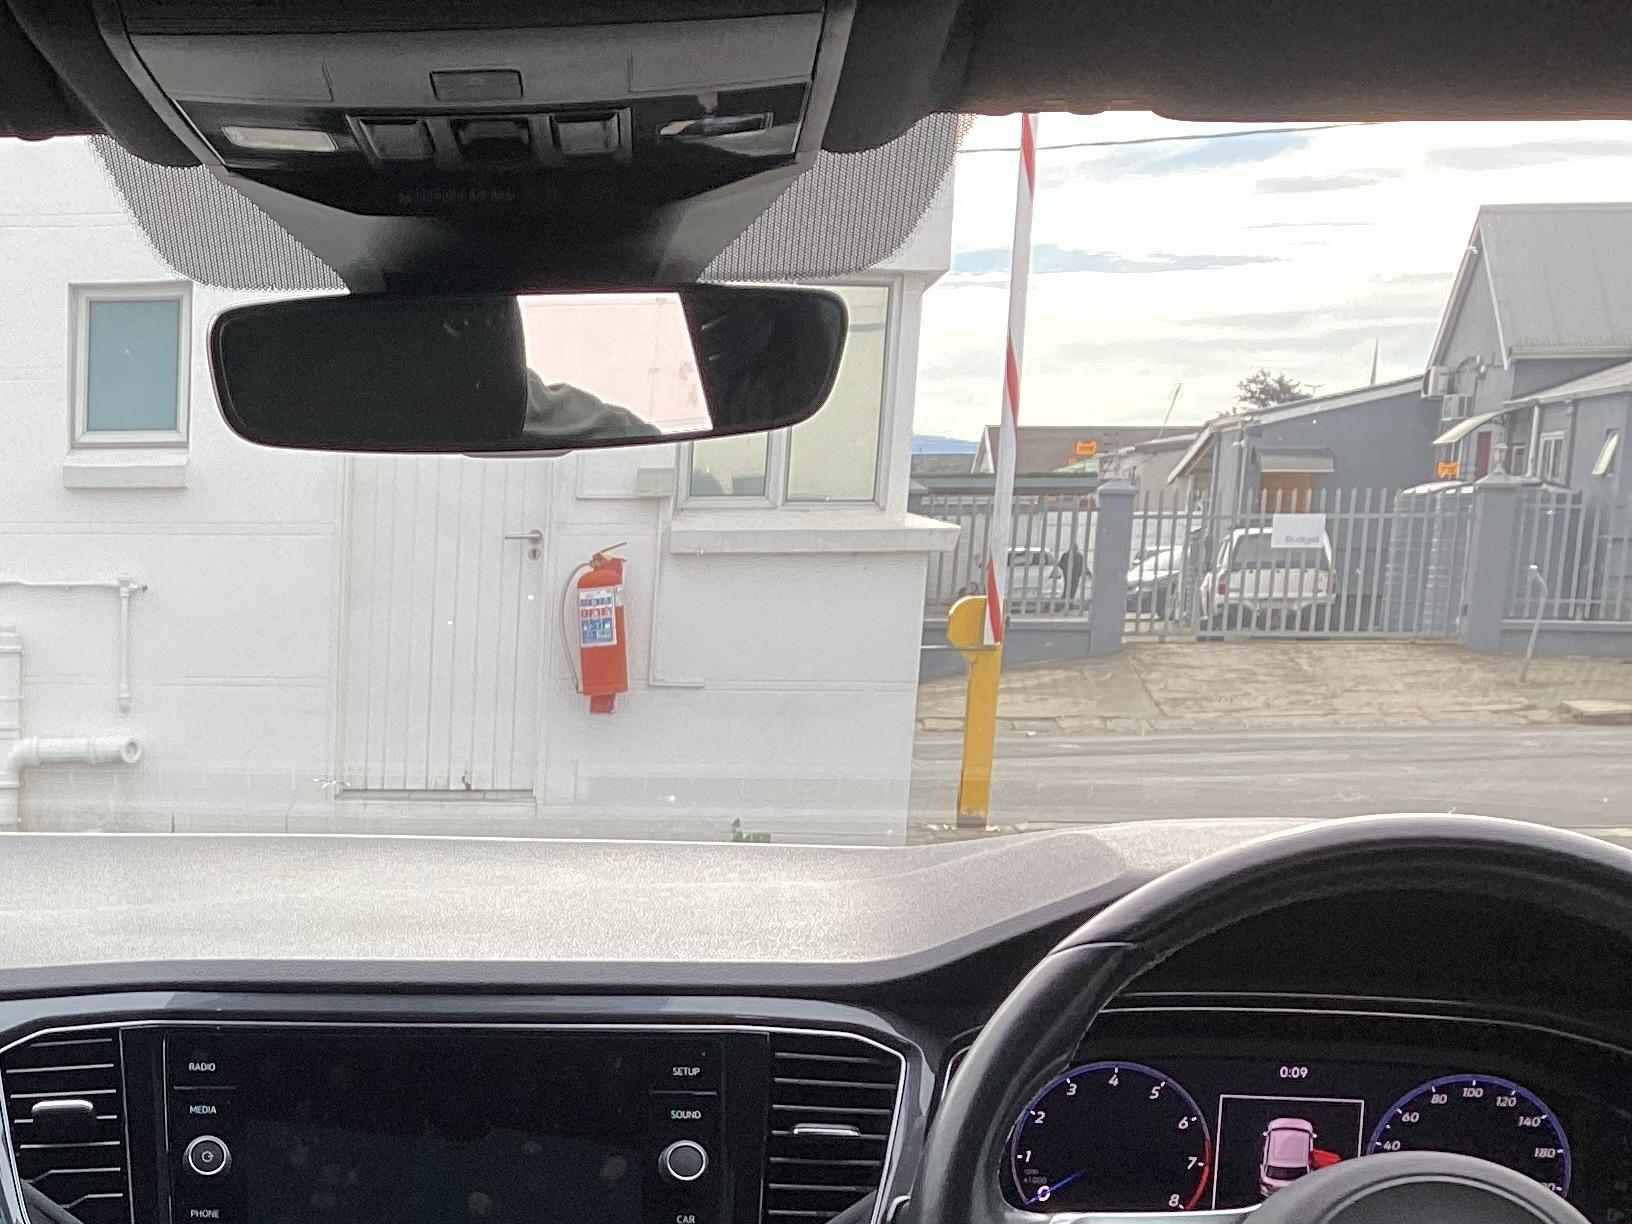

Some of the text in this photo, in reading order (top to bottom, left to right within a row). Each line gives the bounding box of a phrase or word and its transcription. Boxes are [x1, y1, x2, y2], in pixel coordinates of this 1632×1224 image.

[188, 1062, 216, 1072] RADIO
[672, 1067, 700, 1076] SETUP
[1279, 1066, 1308, 1078] 0:09
[1108, 1075, 1118, 1087] 4
[1066, 1084, 1077, 1096] 3
[1149, 1086, 1160, 1099] 5
[1462, 1087, 1484, 1098] 100
[1431, 1094, 1448, 1104] 80
[1496, 1096, 1517, 1107] 120
[189, 1105, 217, 1114] MEDIA
[671, 1110, 701, 1119] SOUND
[1034, 1111, 1046, 1124] 2
[1178, 1116, 1189, 1129] 6
[1402, 1112, 1420, 1123] 60
[1518, 1116, 1541, 1127] 140
[1383, 1140, 1401, 1151] 40
[1025, 1150, 1032, 1162] 1
[1187, 1156, 1197, 1170] 7
[1037, 1185, 1051, 1201] 0
[1168, 1193, 1180, 1207] 8
[190, 1209, 219, 1218] PHONE
[676, 1215, 696, 1224] CAR
